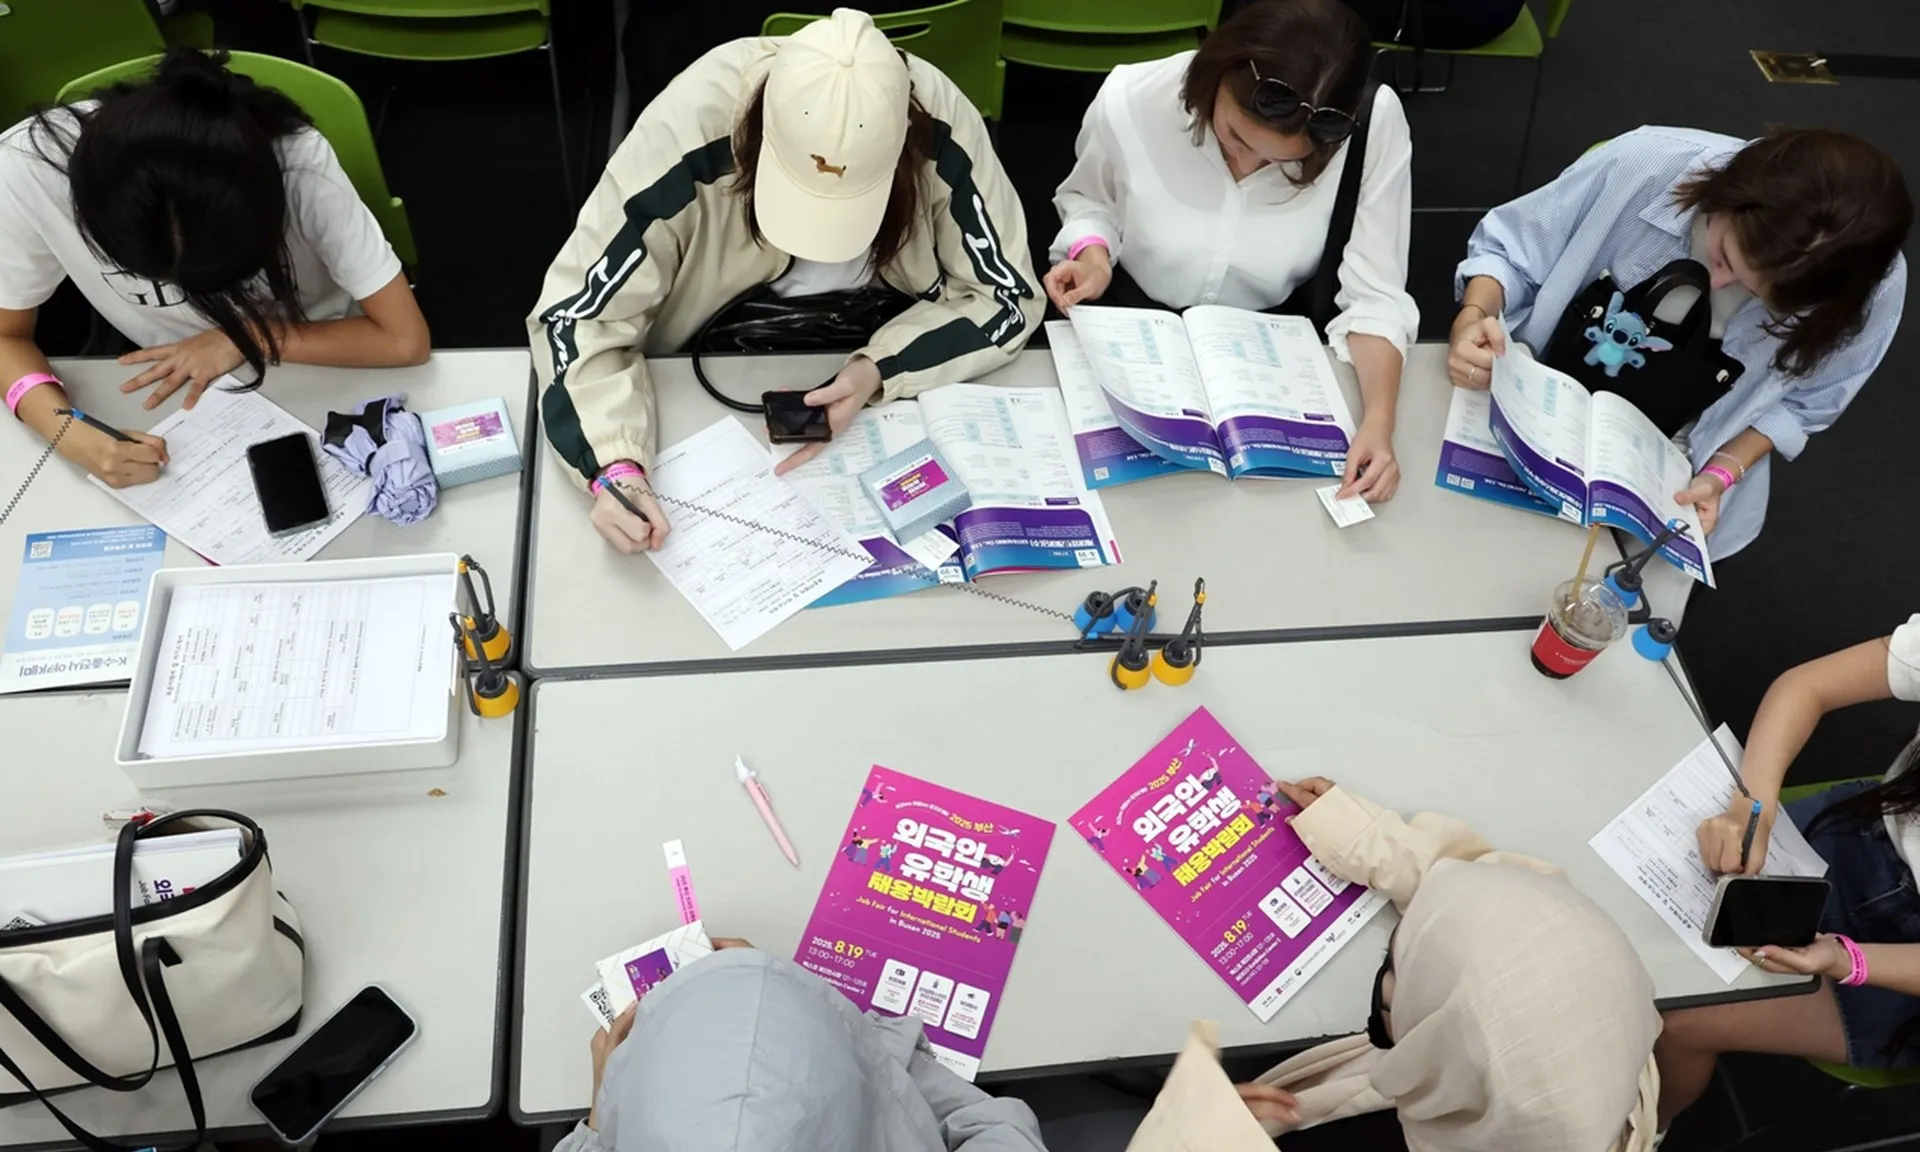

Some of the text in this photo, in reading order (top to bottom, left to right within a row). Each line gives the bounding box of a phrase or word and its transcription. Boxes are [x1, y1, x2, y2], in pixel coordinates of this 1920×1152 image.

[1145, 754, 1185, 794] 2025 부산
[946, 812, 996, 836] 2025 부산
[1132, 773, 1209, 844] 외국인
[1168, 785, 1243, 854] 유학생
[892, 818, 988, 869] 외국인
[1172, 812, 1255, 887] 채용박람회
[867, 870, 978, 924] 채용박람회
[899, 852, 995, 904] 유학생
[898, 909, 949, 933] International
[946, 925, 982, 945] Students
